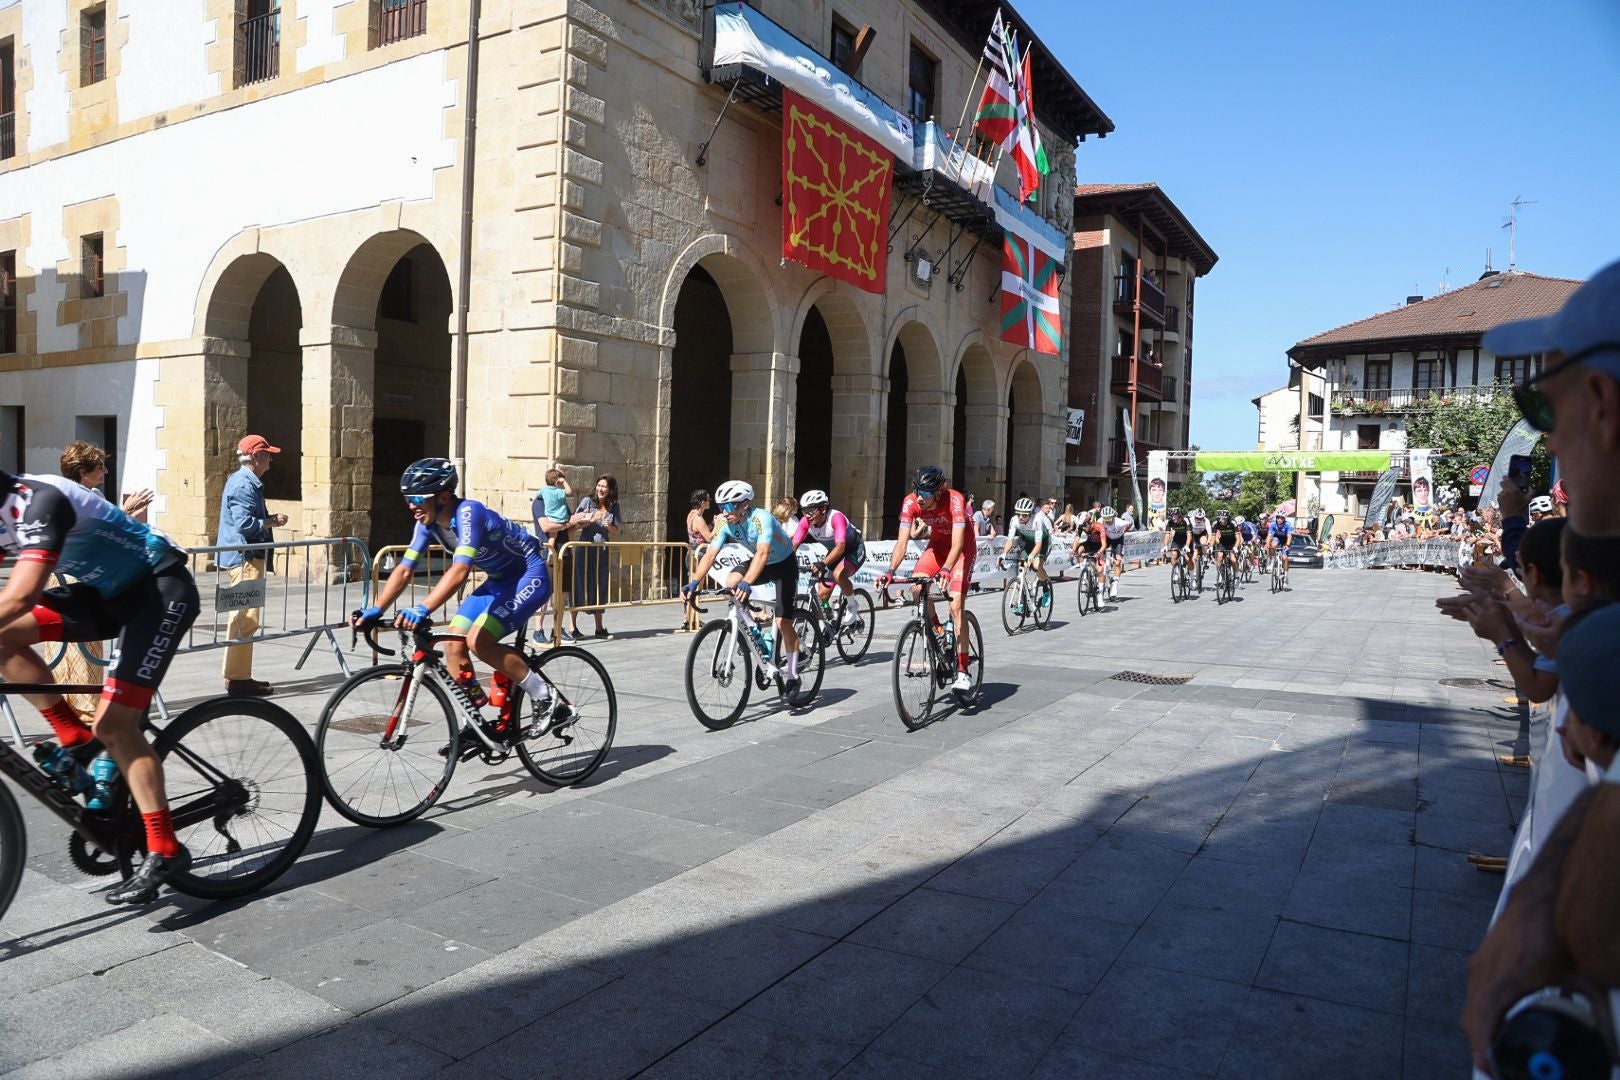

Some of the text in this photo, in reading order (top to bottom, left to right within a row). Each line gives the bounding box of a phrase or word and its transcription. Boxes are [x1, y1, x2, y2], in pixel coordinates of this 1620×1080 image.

[461, 511, 472, 545] OVIEDO
[228, 599, 250, 608] UDALA
[504, 577, 542, 611] OVIEDO
[136, 600, 188, 680] PERSEUS
